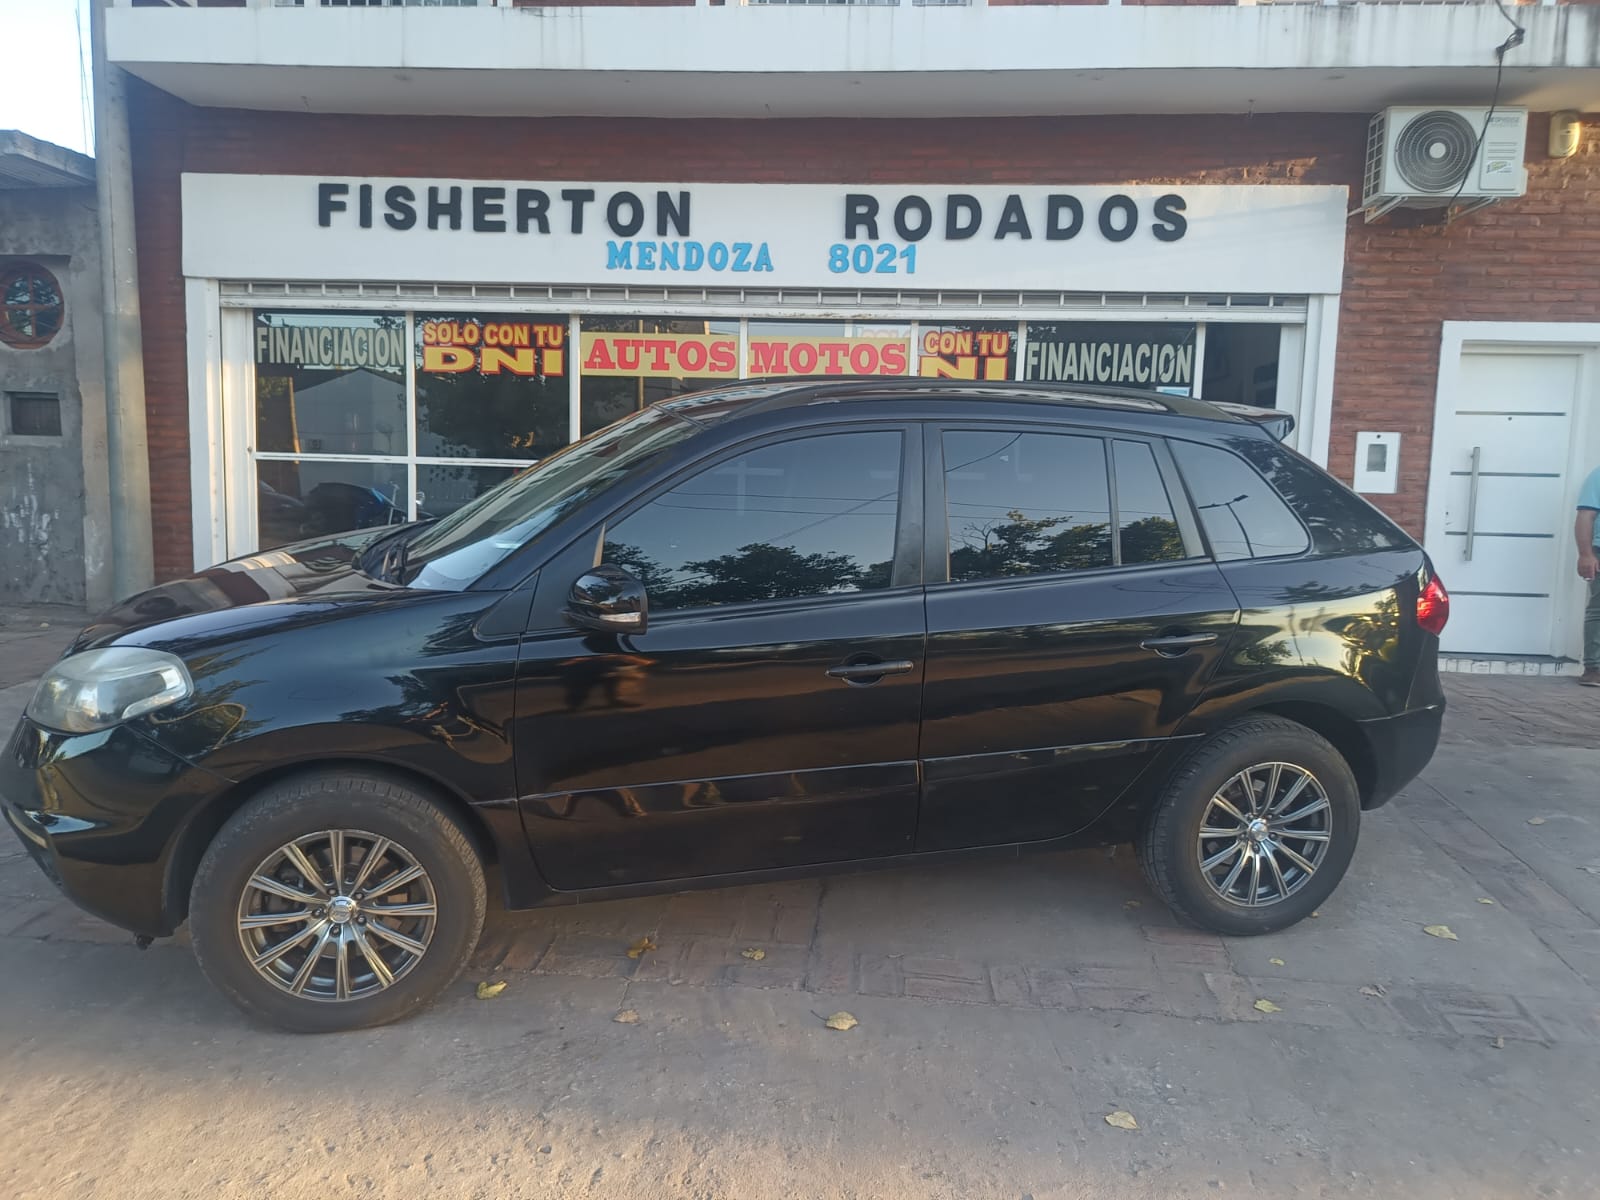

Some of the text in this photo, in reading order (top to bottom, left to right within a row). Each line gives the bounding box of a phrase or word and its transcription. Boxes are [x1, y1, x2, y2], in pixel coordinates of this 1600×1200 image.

[317, 182, 1188, 242] FISHERTON RODADOS
[606, 241, 917, 273] MENDOZA 8021
[256, 326, 405, 367] FINANCIACION
[422, 321, 564, 347] SOLO CON TU
[924, 331, 1009, 356] CON TU
[422, 345, 565, 377] DNI
[584, 338, 906, 375] AUTOS MOTOS
[919, 355, 1009, 381] NI
[1026, 342, 1193, 383] FINANCIACION
